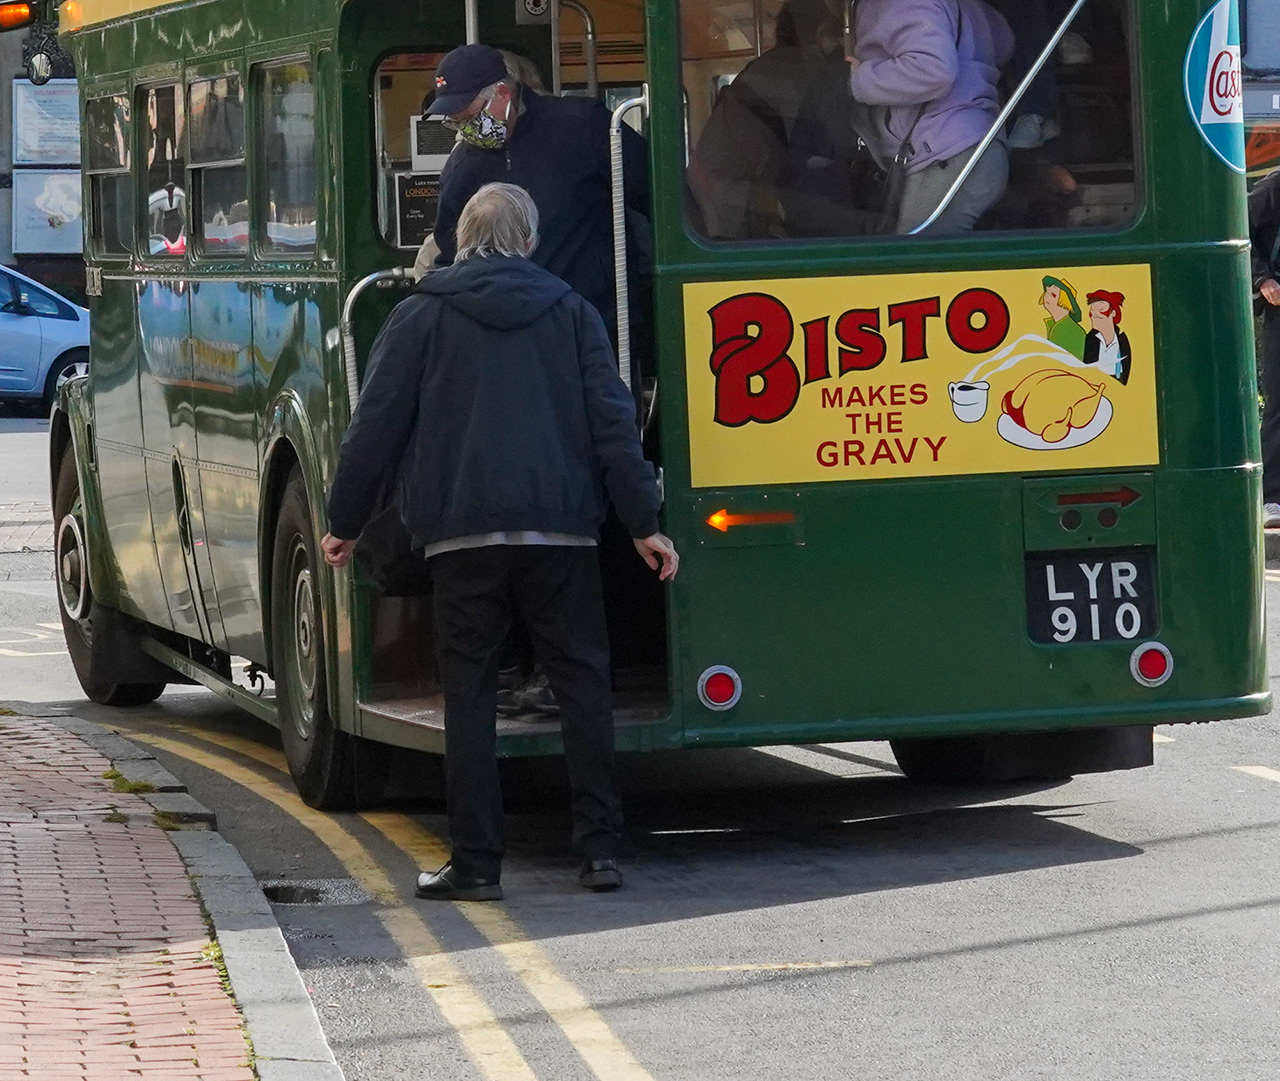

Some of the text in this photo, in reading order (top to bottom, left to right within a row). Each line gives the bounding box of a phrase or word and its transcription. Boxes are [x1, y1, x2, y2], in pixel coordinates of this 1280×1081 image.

[1209, 50, 1241, 116] Cast
[405, 188, 438, 198] LONDON
[706, 286, 1010, 428] BISTO
[822, 383, 928, 408] MAKES
[845, 412, 903, 434] THE
[816, 436, 948, 468] GRAVY
[1046, 561, 1139, 601] LYR
[1051, 602, 1142, 643] 910
